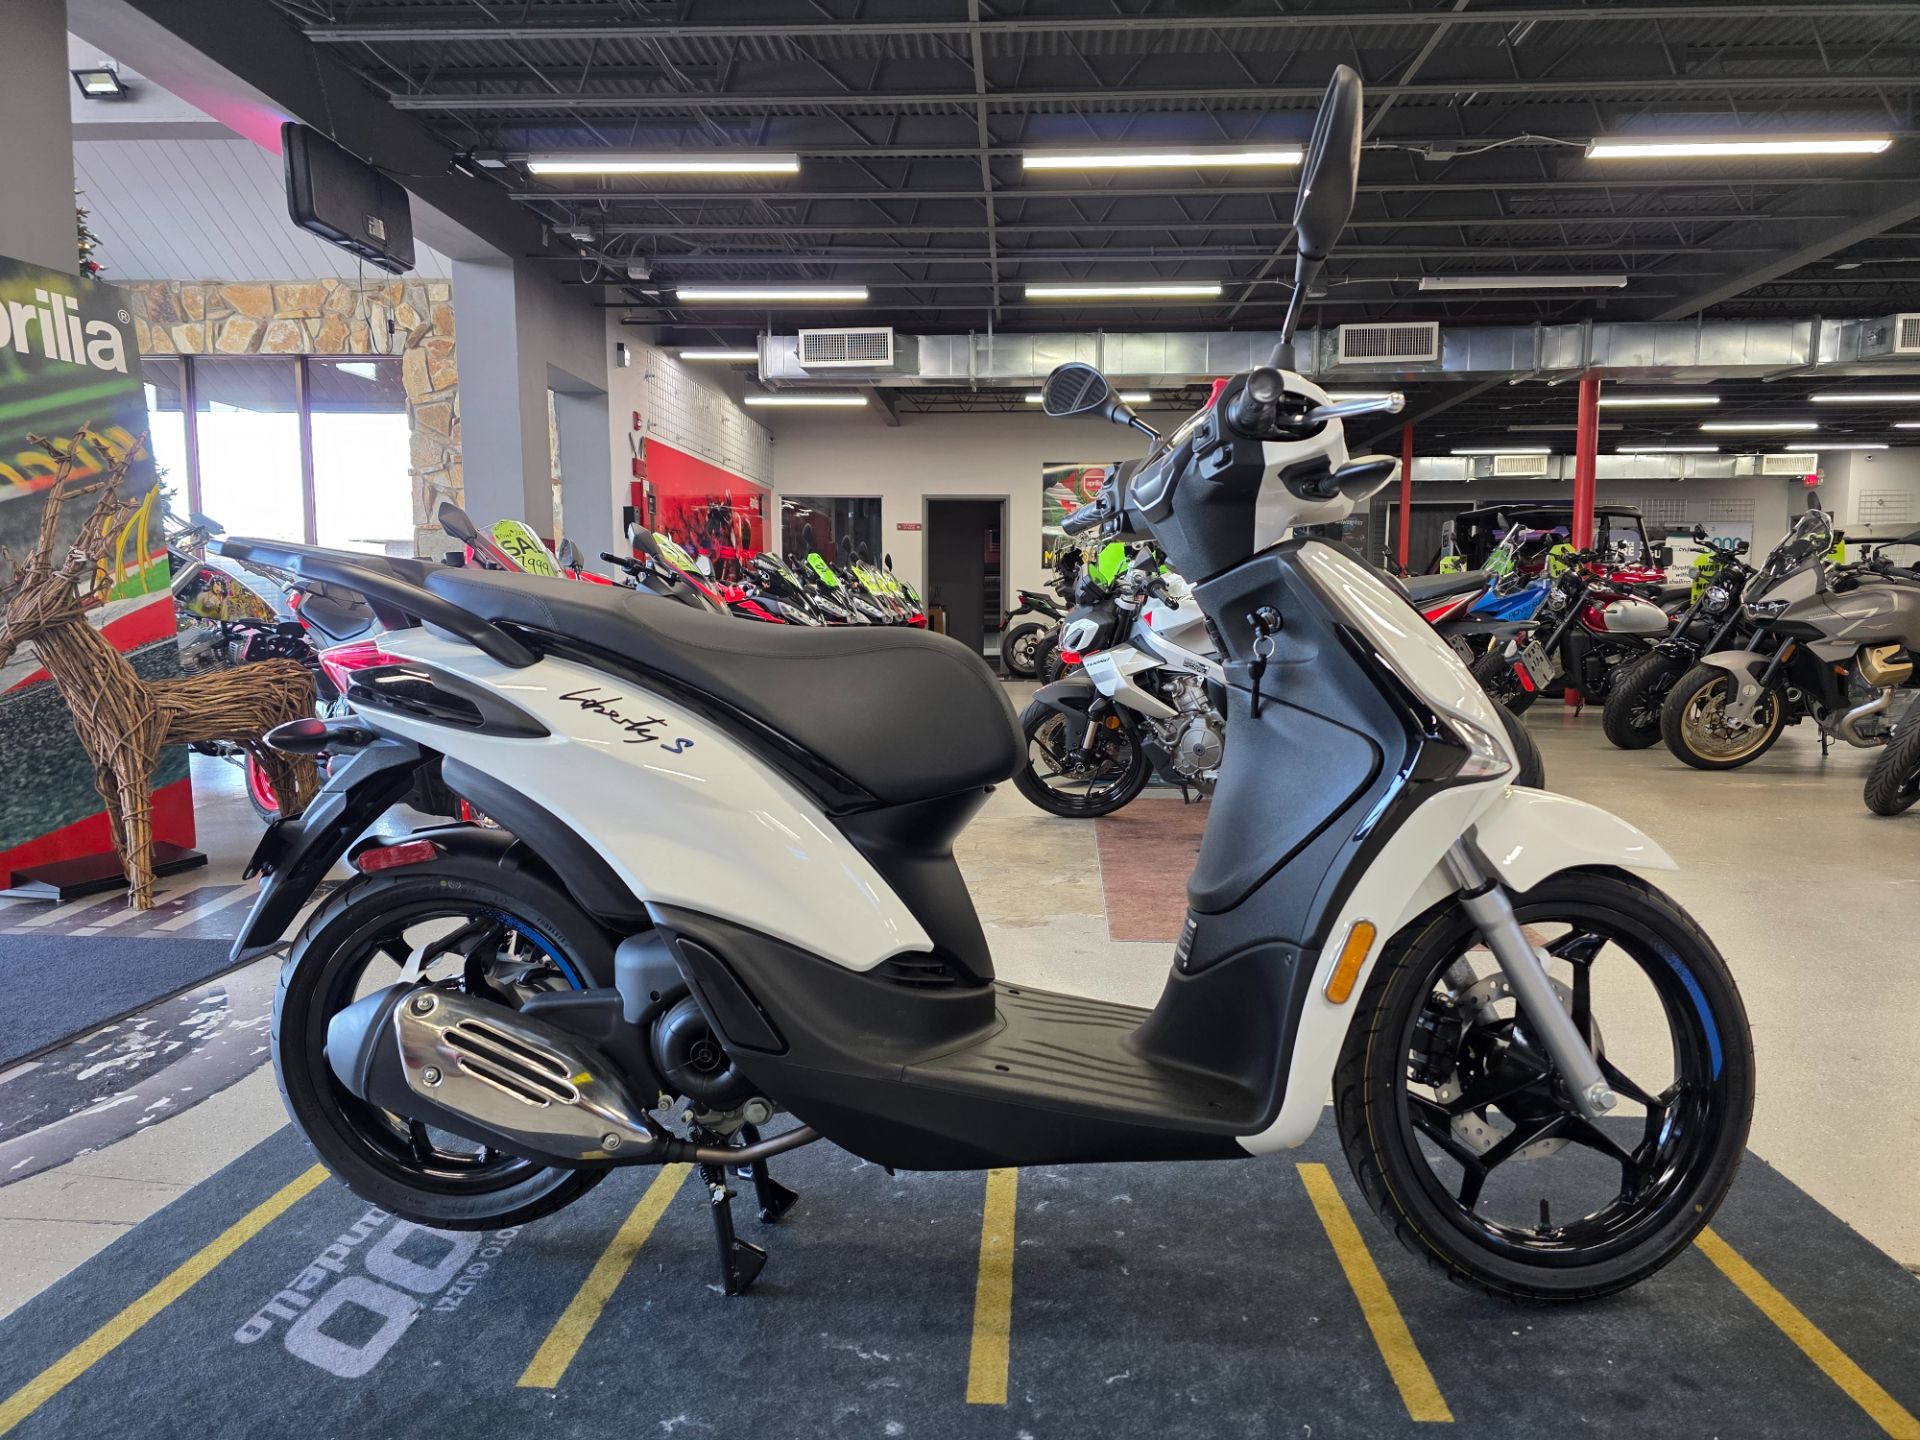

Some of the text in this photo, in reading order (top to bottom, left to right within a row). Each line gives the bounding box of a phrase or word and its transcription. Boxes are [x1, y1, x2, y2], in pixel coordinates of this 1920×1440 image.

[500, 536, 544, 557] SAL
[558, 687, 695, 754] Liberty S
[432, 1225, 522, 1312] OTO GUZZI
